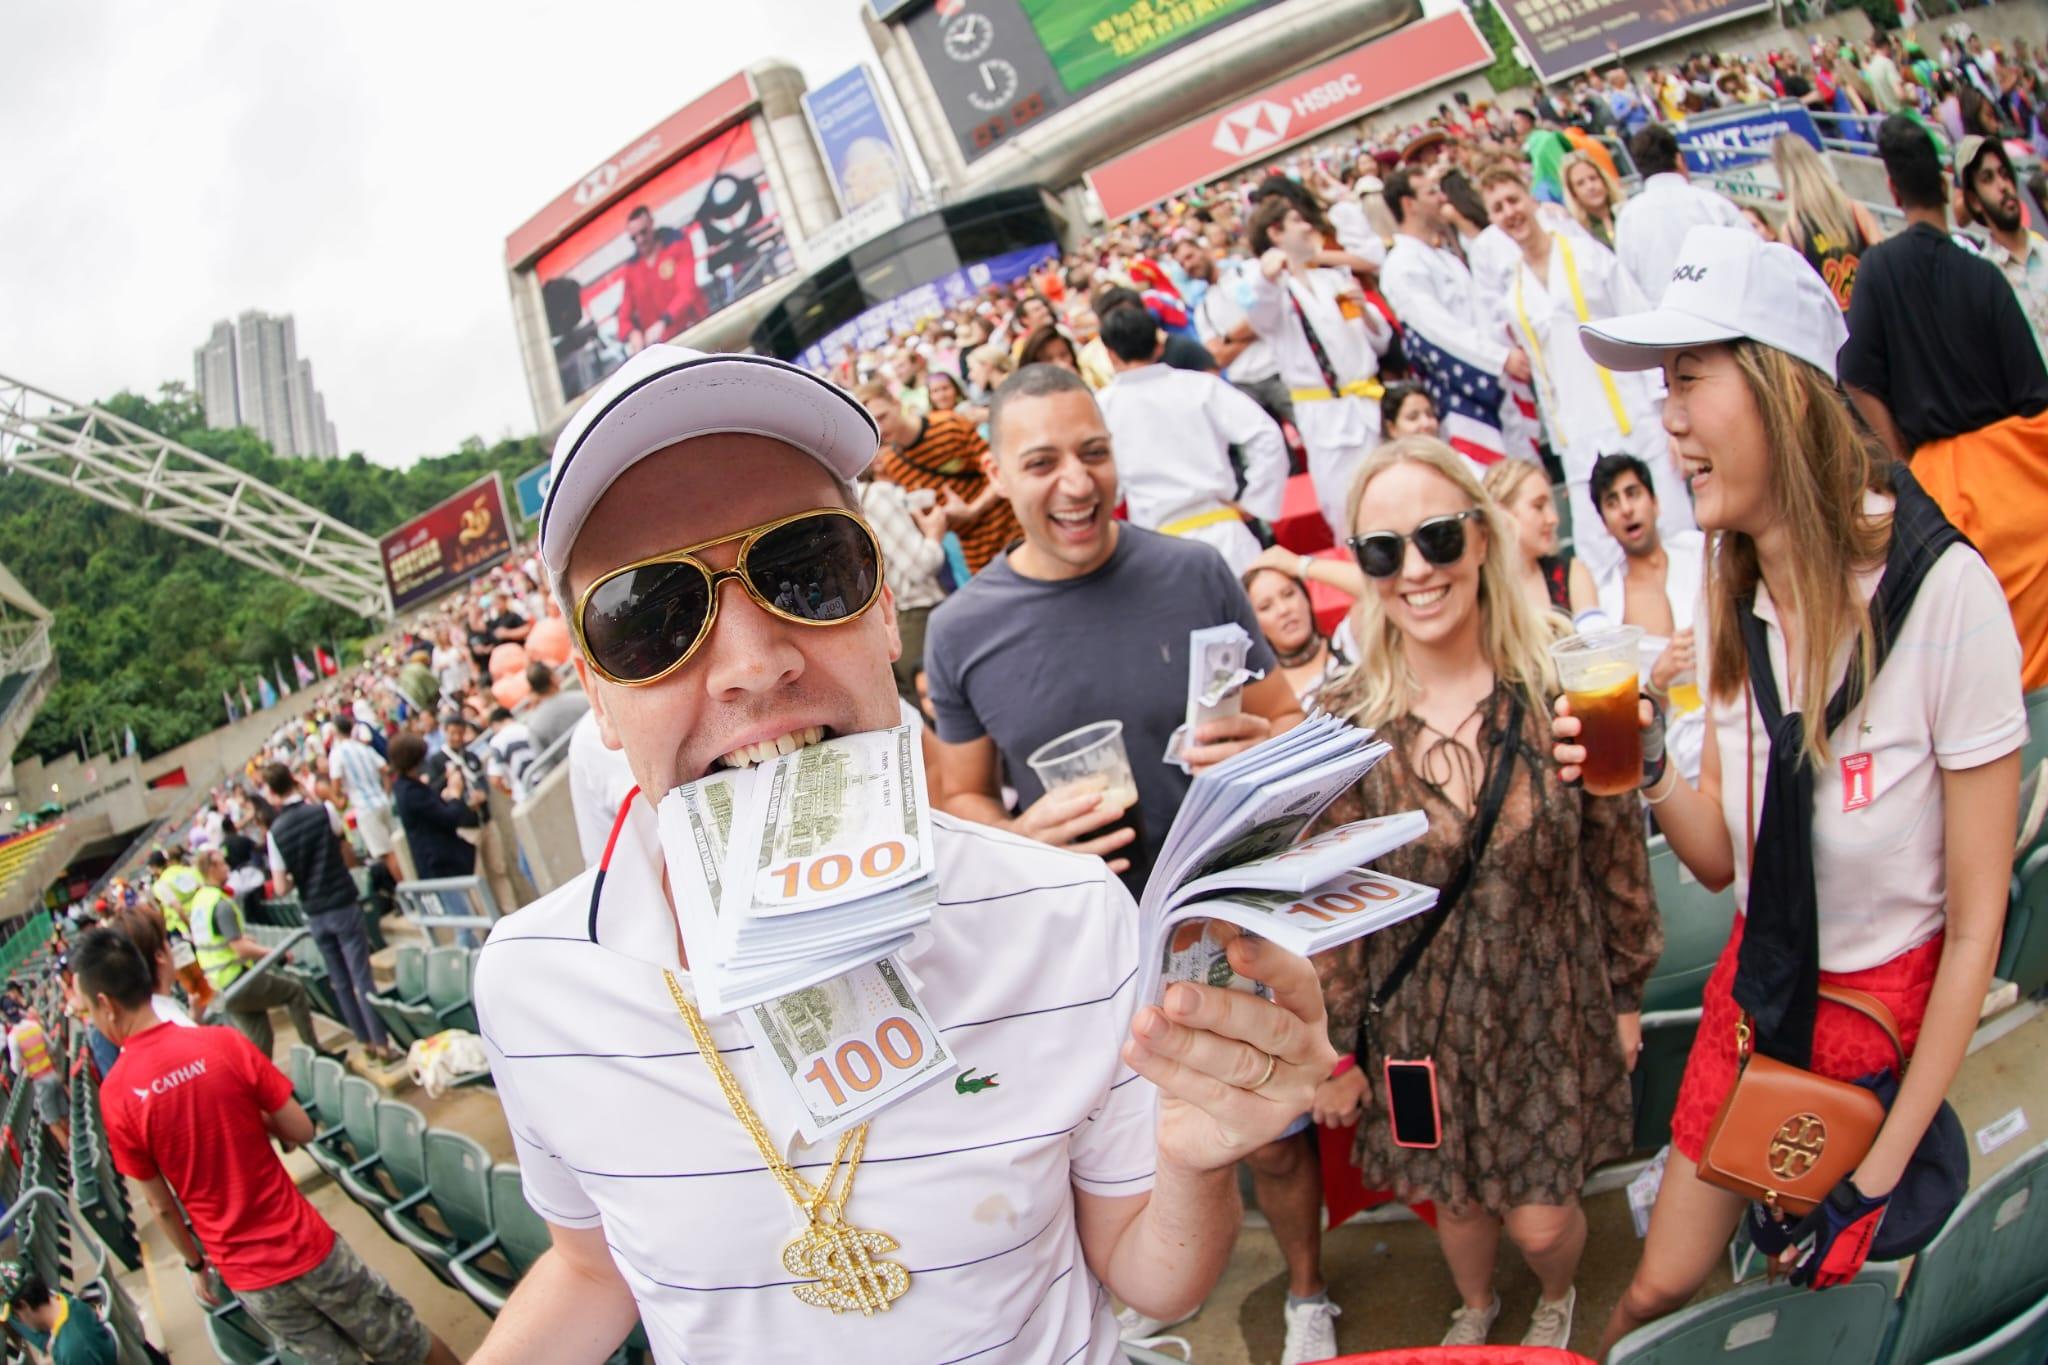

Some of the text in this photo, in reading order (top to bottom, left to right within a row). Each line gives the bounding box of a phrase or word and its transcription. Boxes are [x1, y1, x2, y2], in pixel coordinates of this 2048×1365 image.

[1292, 73, 1363, 118] HSBC
[770, 840, 906, 898] 100
[1285, 881, 1400, 922] 100
[151, 1058, 207, 1095] CATHAY
[804, 1016, 924, 1107] 100
